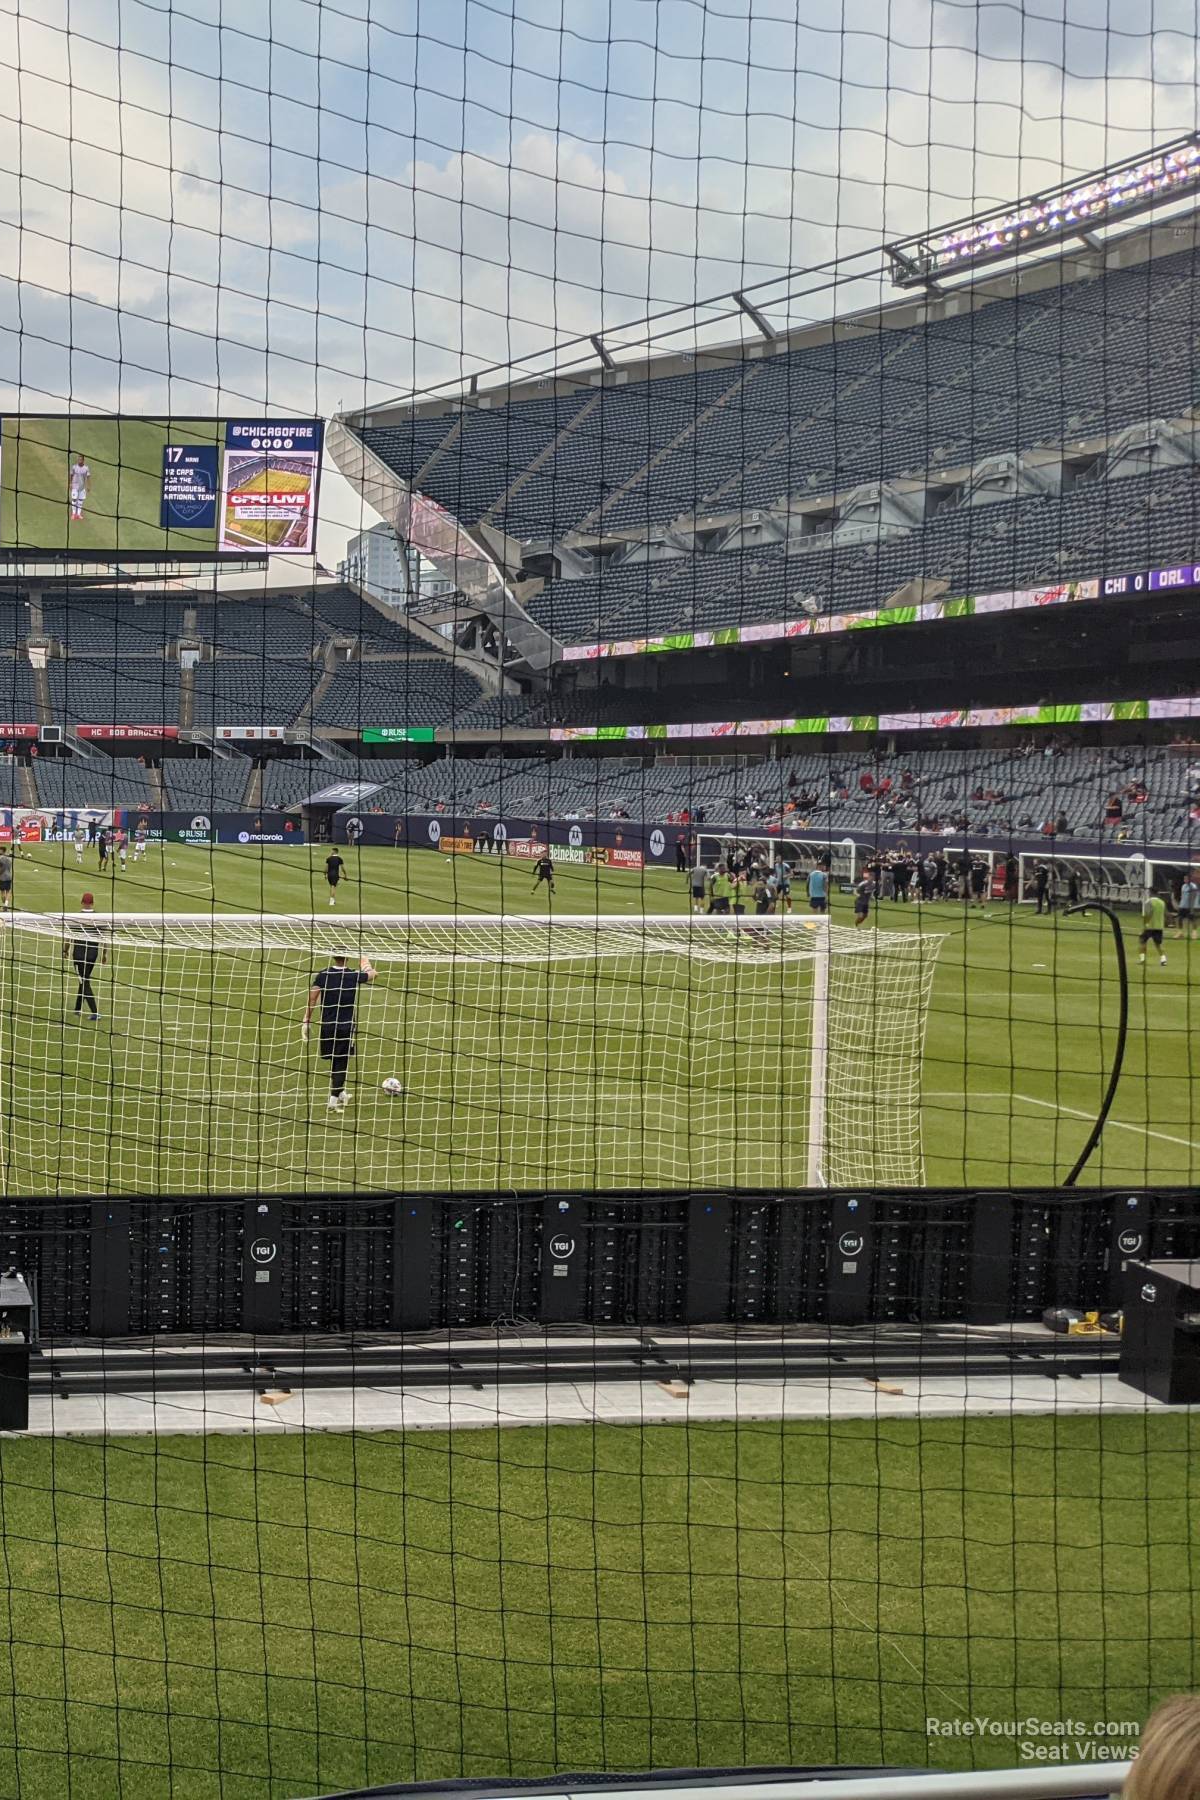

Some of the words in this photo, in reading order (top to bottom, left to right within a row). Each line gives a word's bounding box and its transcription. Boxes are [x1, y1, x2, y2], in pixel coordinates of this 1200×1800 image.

[232, 427, 313, 438] @CHICAGOFIRE
[166, 447, 183, 463] 17
[176, 468, 194, 476] CAPS
[164, 485, 206, 493] PORTUGUESE
[163, 493, 196, 501] NATIONAL
[273, 494, 306, 503] LIVE
[1159, 569, 1185, 587] ORL
[1105, 577, 1126, 594] CHI
[1134, 576, 1142, 590] 0
[7, 727, 26, 735] WILT
[92, 728, 102, 736] HC
[128, 729, 164, 737] BRADLEY
[256, 1247, 270, 1255] TGI
